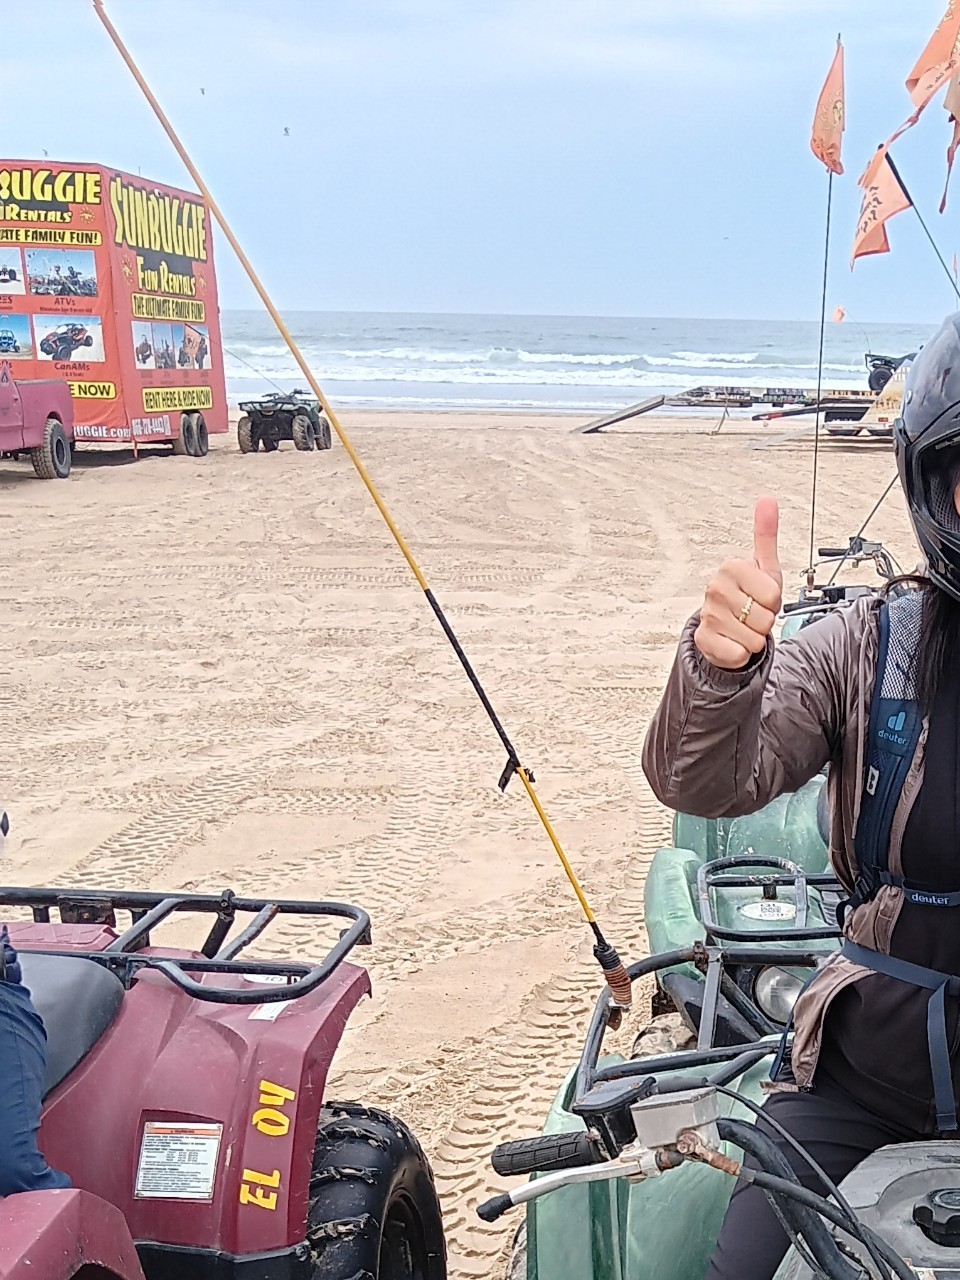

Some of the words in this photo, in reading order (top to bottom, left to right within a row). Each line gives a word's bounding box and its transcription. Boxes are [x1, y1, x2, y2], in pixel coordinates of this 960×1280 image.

[110, 177, 207, 261] SUNBUGGIE
[24, 229, 66, 243] FAMILY
[70, 231, 98, 244] FUN!
[54, 297, 76, 306] ATVs
[78, 385, 111, 396] NOW
[144, 391, 161, 410] RENT
[161, 391, 178, 409] HERE
[878, 729, 907, 745] deuter
[911, 892, 949, 905] deuter
